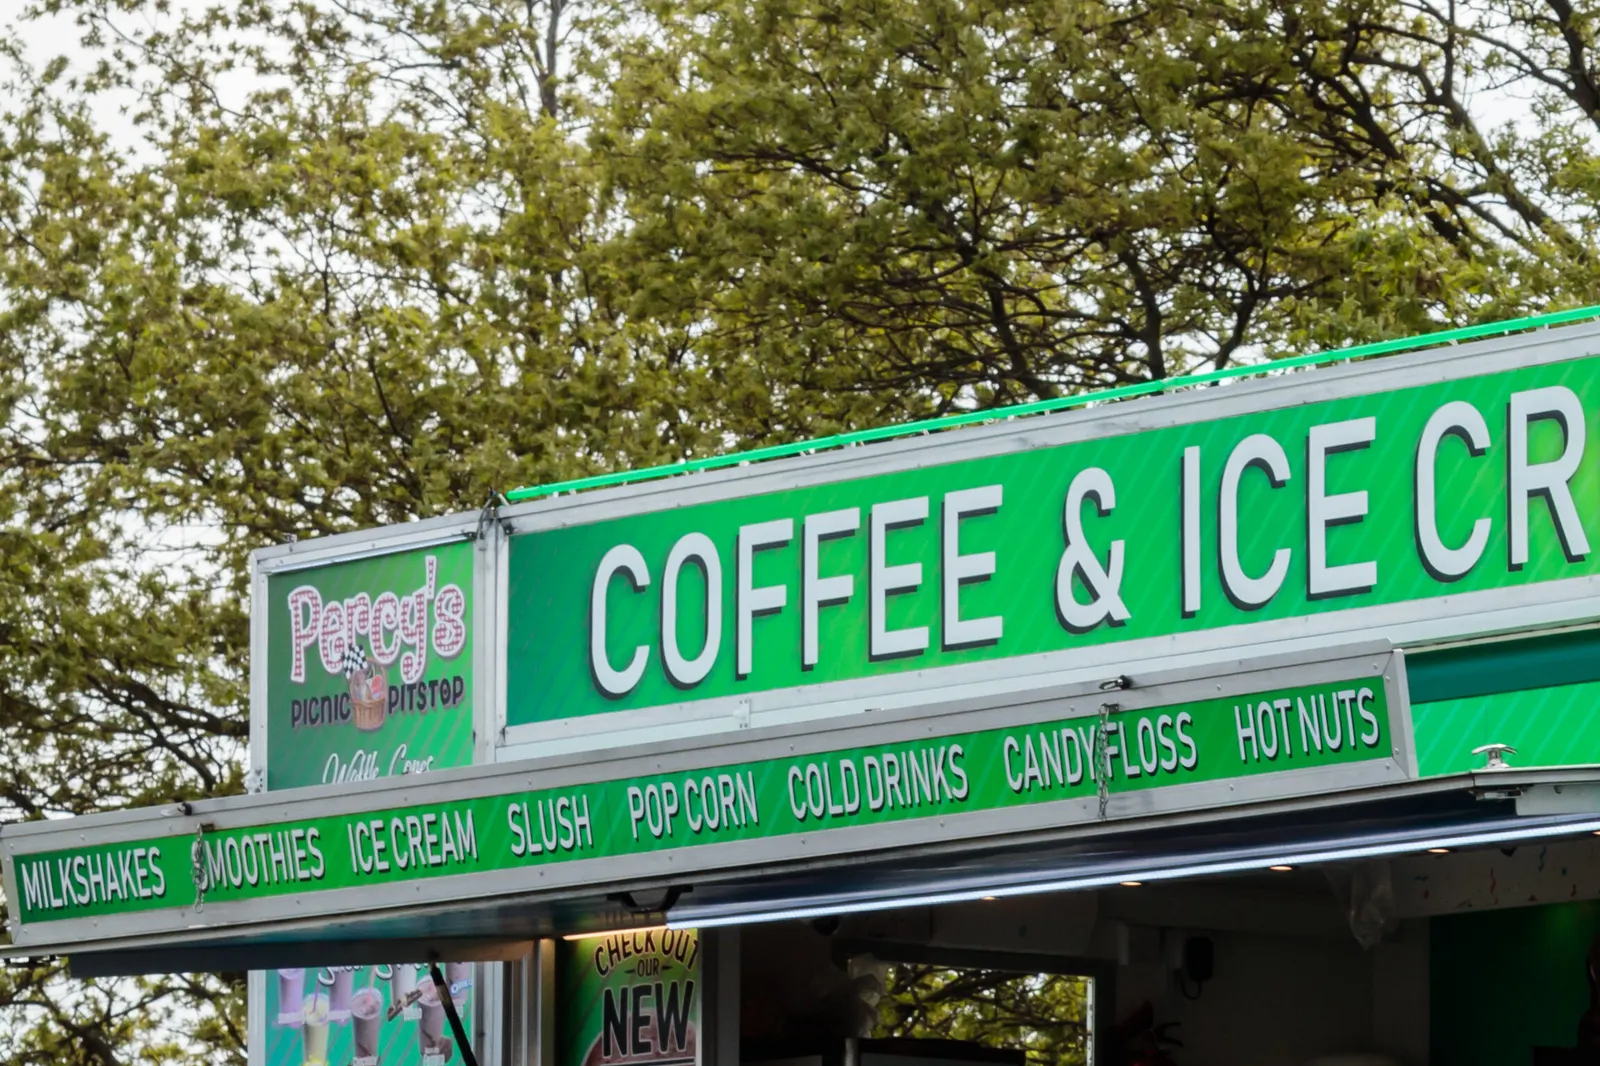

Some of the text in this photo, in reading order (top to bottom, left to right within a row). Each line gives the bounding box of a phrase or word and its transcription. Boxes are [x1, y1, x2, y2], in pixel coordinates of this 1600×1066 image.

[589, 484, 1003, 699] COFFEE
[1056, 467, 1132, 635] &
[1181, 416, 1378, 619] ICE
[287, 555, 466, 683] Percy's
[291, 675, 465, 729] PICNIC PITSTOP
[20, 687, 1380, 911] MILKSHAKES SMOOTHIES ICE CREAM SLUSH POP CORN COLD DRINKS CANDY FLOSS HOT NUTS
[594, 929, 657, 976] CHECK
[637, 958, 659, 977] OUR
[602, 980, 694, 1058] NEW
